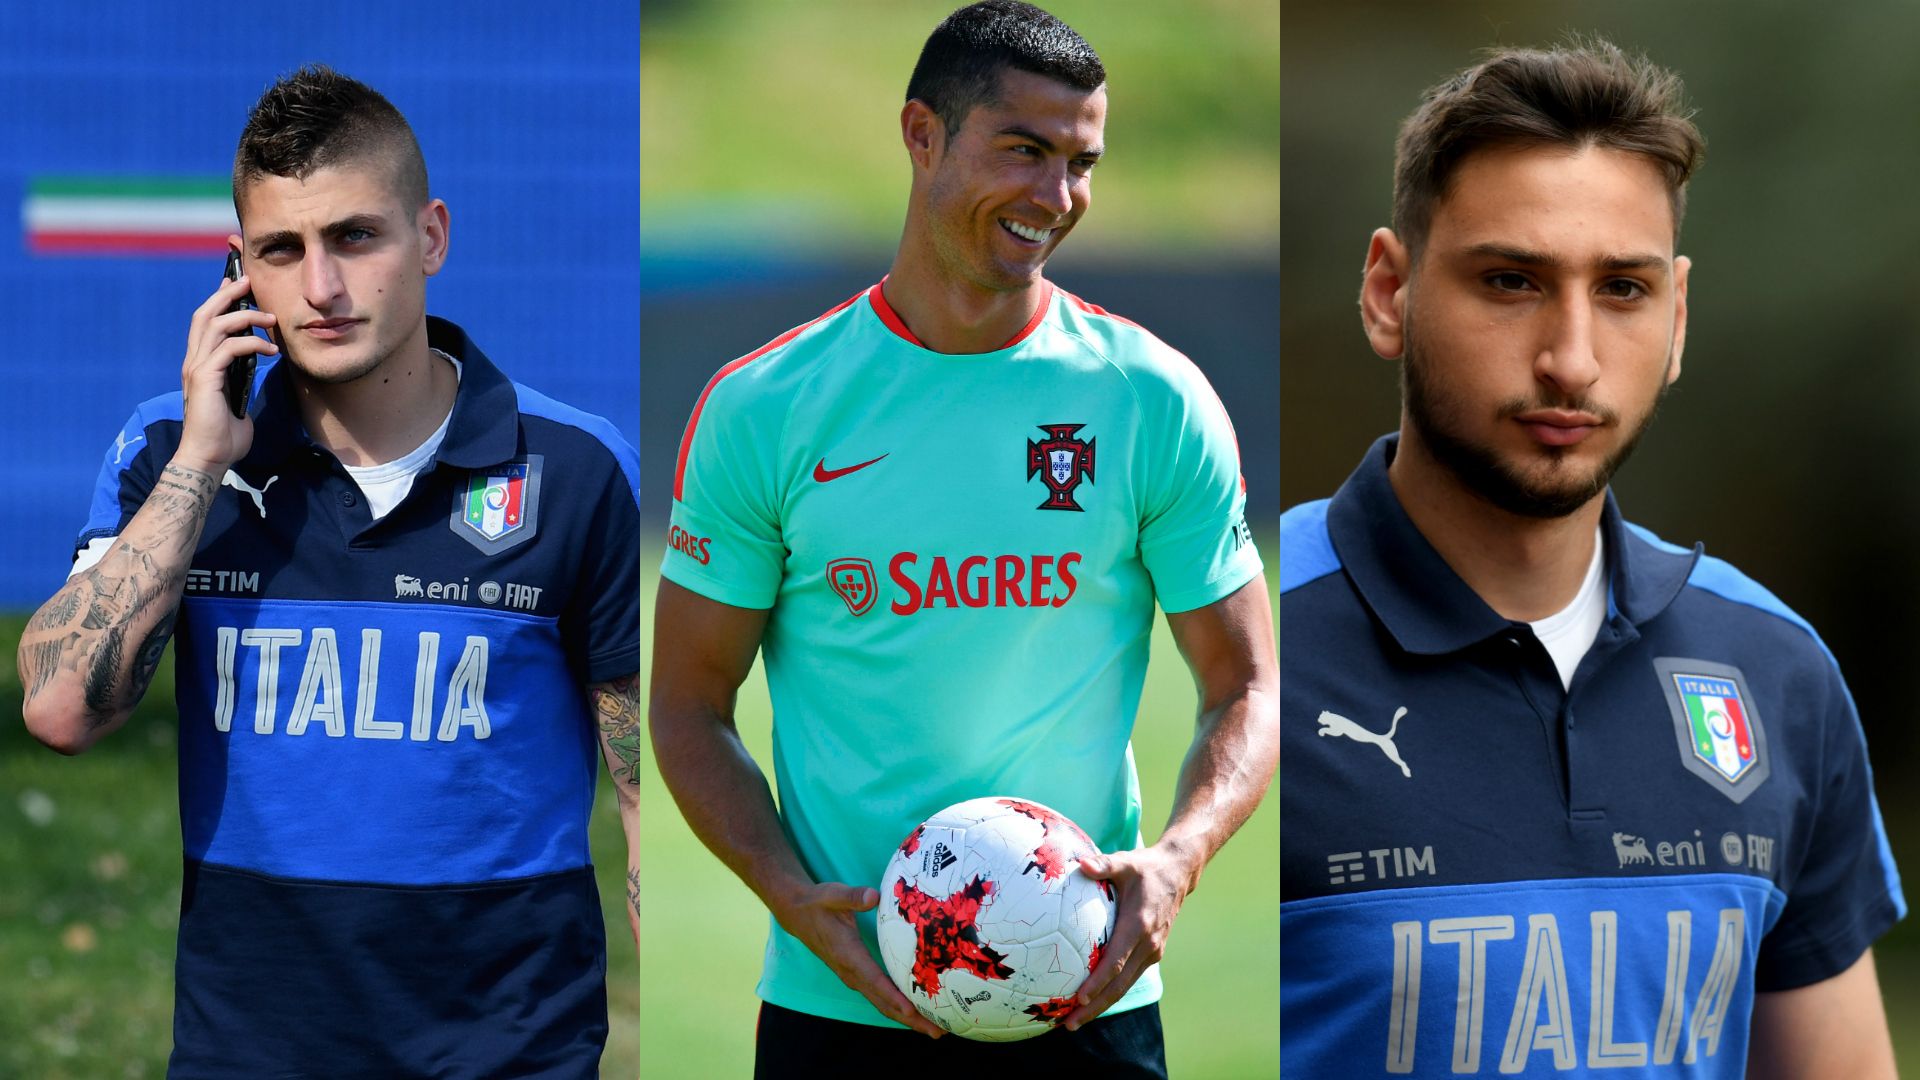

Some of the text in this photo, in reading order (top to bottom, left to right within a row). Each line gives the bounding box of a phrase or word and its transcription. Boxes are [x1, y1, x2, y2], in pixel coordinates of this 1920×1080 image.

[668, 525, 711, 566] GRES
[215, 570, 260, 593] TIM
[427, 576, 470, 601] eni
[504, 582, 543, 610] FIAT
[888, 551, 1082, 616] SAGRES
[214, 627, 491, 742] ITALIA
[1684, 681, 1731, 697] ITALIA
[931, 842, 943, 878] adidas
[1368, 845, 1436, 879] TIM
[1656, 829, 1706, 867] eni
[1747, 833, 1775, 873] FIAT
[1385, 908, 1745, 1074] ITALIA
